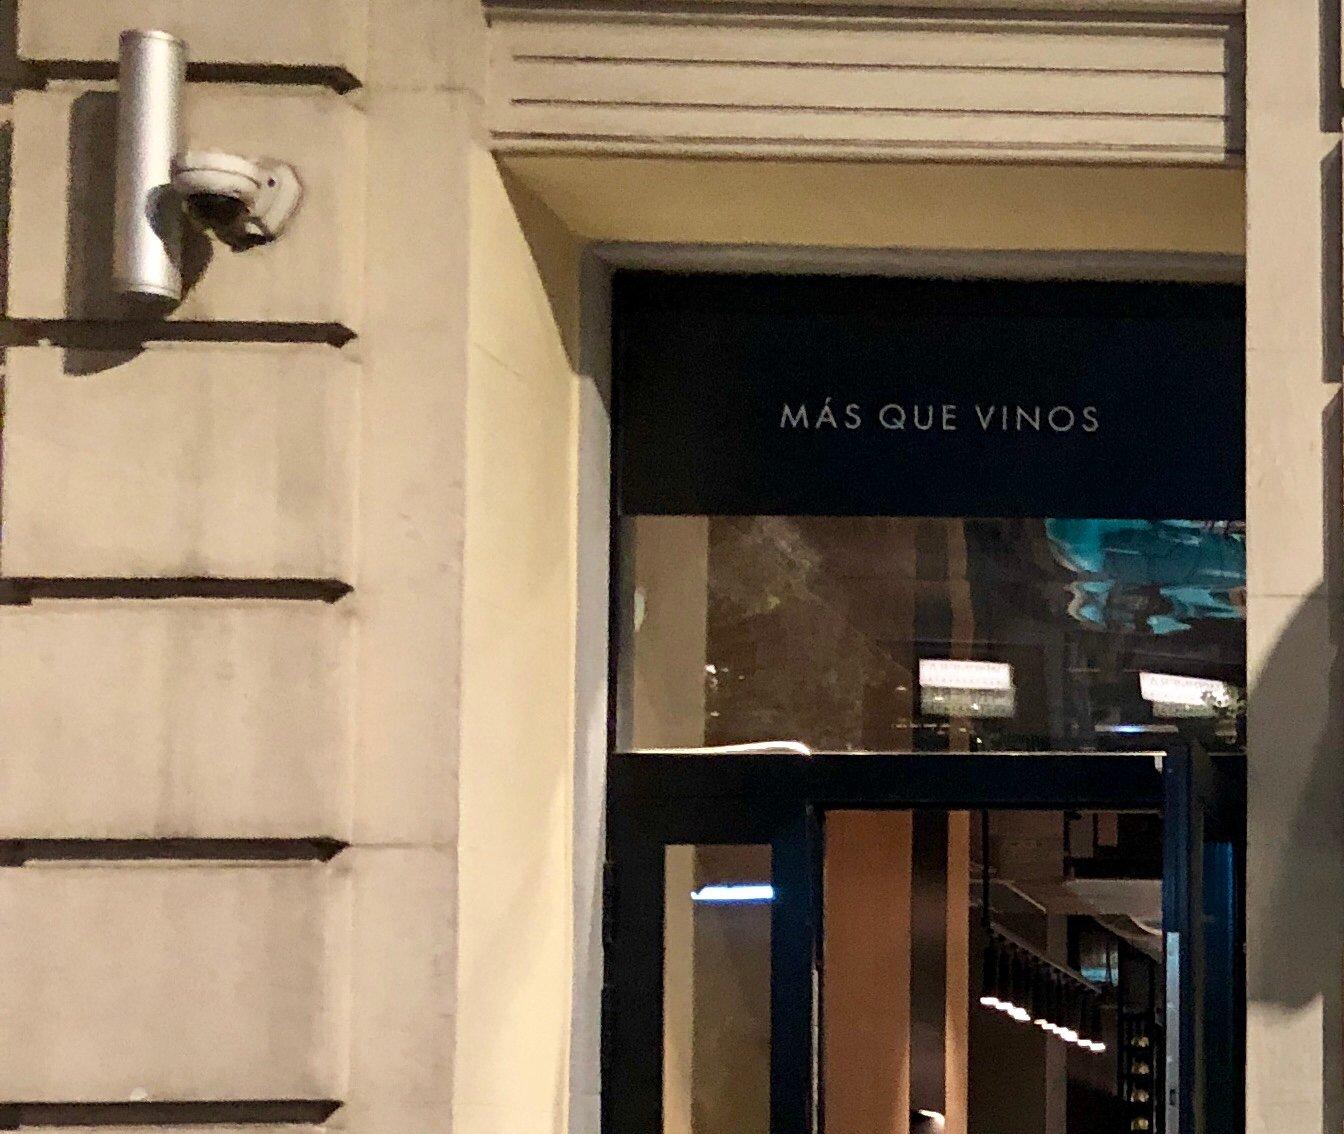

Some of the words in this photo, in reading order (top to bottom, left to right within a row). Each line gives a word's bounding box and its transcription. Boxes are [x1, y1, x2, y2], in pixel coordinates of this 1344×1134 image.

[780, 397, 862, 430] MÁS
[878, 403, 957, 430] QUE
[974, 404, 1099, 432] VINOS
